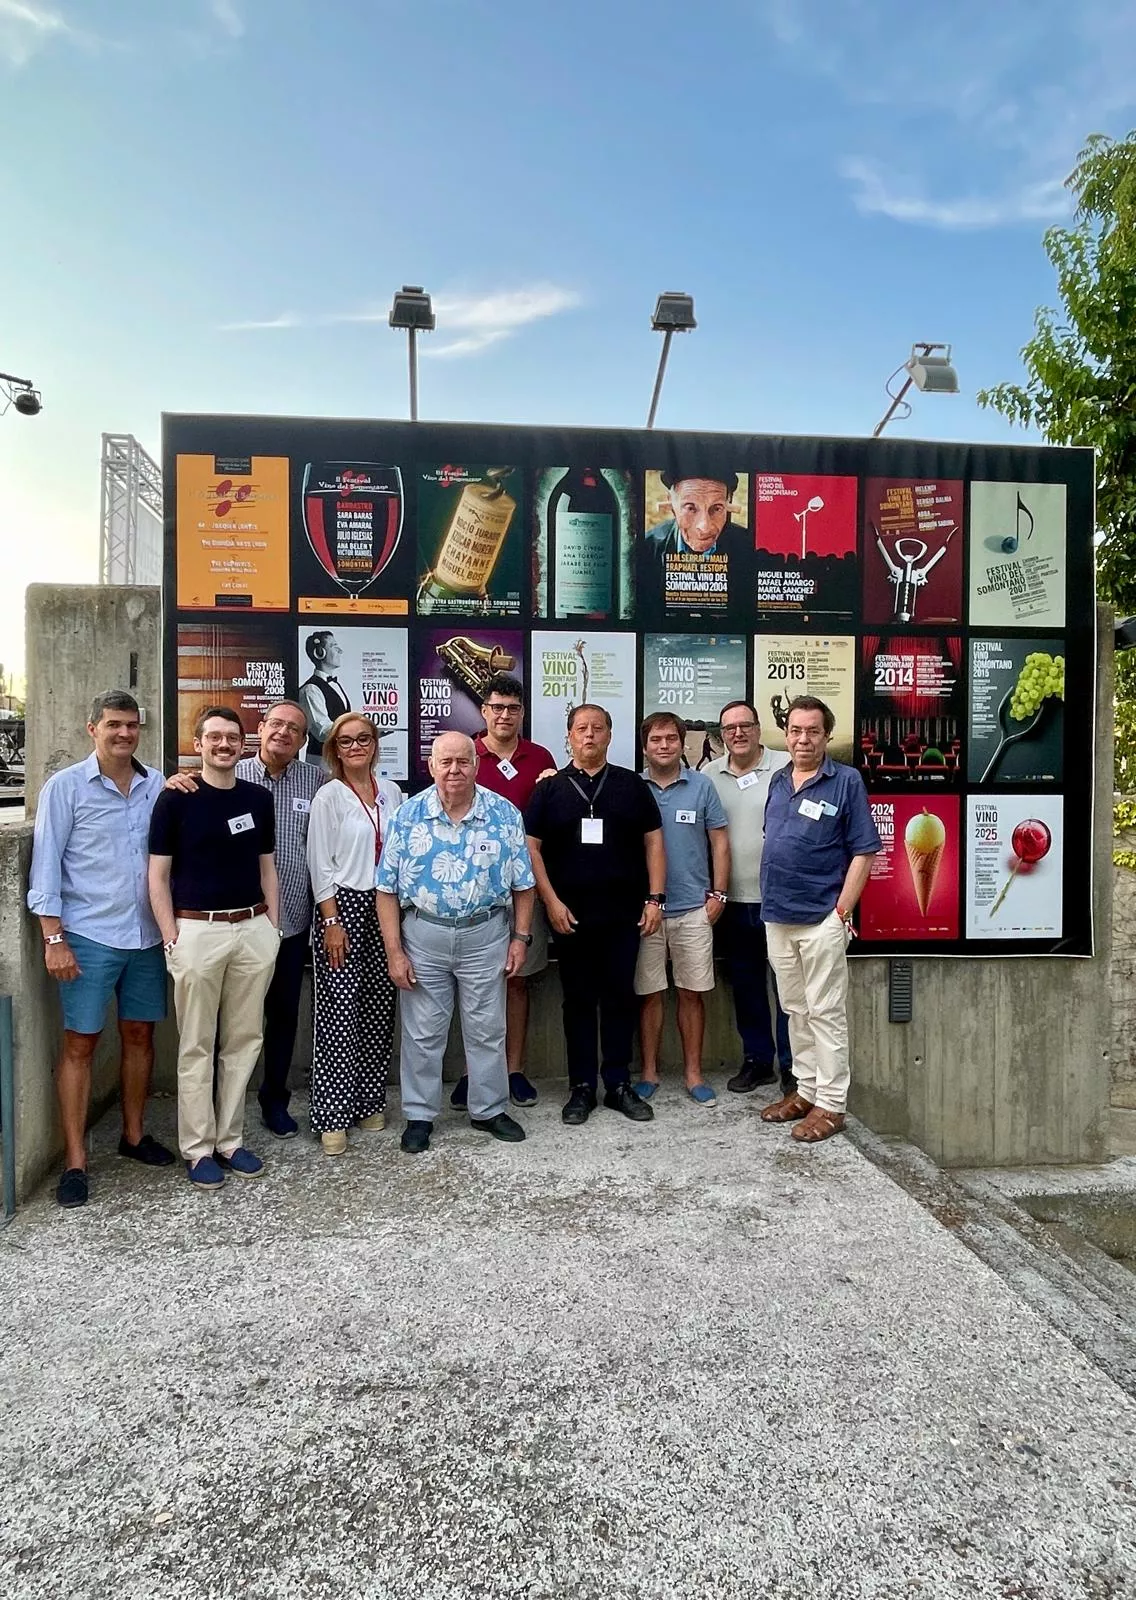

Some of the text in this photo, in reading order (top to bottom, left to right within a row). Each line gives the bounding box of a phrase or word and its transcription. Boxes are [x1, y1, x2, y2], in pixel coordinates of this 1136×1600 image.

[354, 512, 373, 520] BARAS
[669, 563, 728, 573] RAPHAEL ESTOPA
[986, 561, 1022, 575] FESTIVAL
[665, 572, 728, 582] FESTIVAL VINO DEL
[988, 569, 1024, 584] VINO DEL
[665, 581, 728, 592] SOMONTANO 2004
[977, 576, 1026, 596] SOMONTANO
[1009, 584, 1027, 596] 2007
[786, 594, 804, 602] TYLER
[973, 642, 1003, 651] FESTIVAL
[542, 652, 577, 660] FESTIVAL
[973, 651, 989, 660] VINO
[246, 662, 285, 671] FESTIVAL
[658, 657, 694, 667] FESTIVAL
[973, 659, 1013, 669] SOMONTANO
[543, 661, 577, 675] VINO
[768, 664, 805, 680] 2013
[973, 668, 990, 678] 2015
[247, 671, 285, 679] VINO DEL
[658, 667, 694, 681] VINO
[874, 668, 914, 686] 2014
[232, 678, 285, 687] SOMONTANO
[362, 682, 398, 690] FESTIVAL
[658, 681, 694, 689] SOMONTANO
[264, 686, 285, 695] 2008
[420, 686, 451, 699] VINO
[542, 682, 577, 697] 2011
[362, 691, 398, 705] VINO
[658, 689, 694, 704] 2012
[420, 704, 451, 717] 2010
[870, 804, 894, 816] 2024
[975, 811, 998, 823] VINO
[875, 823, 894, 835] INO
[975, 828, 998, 841] 2025
